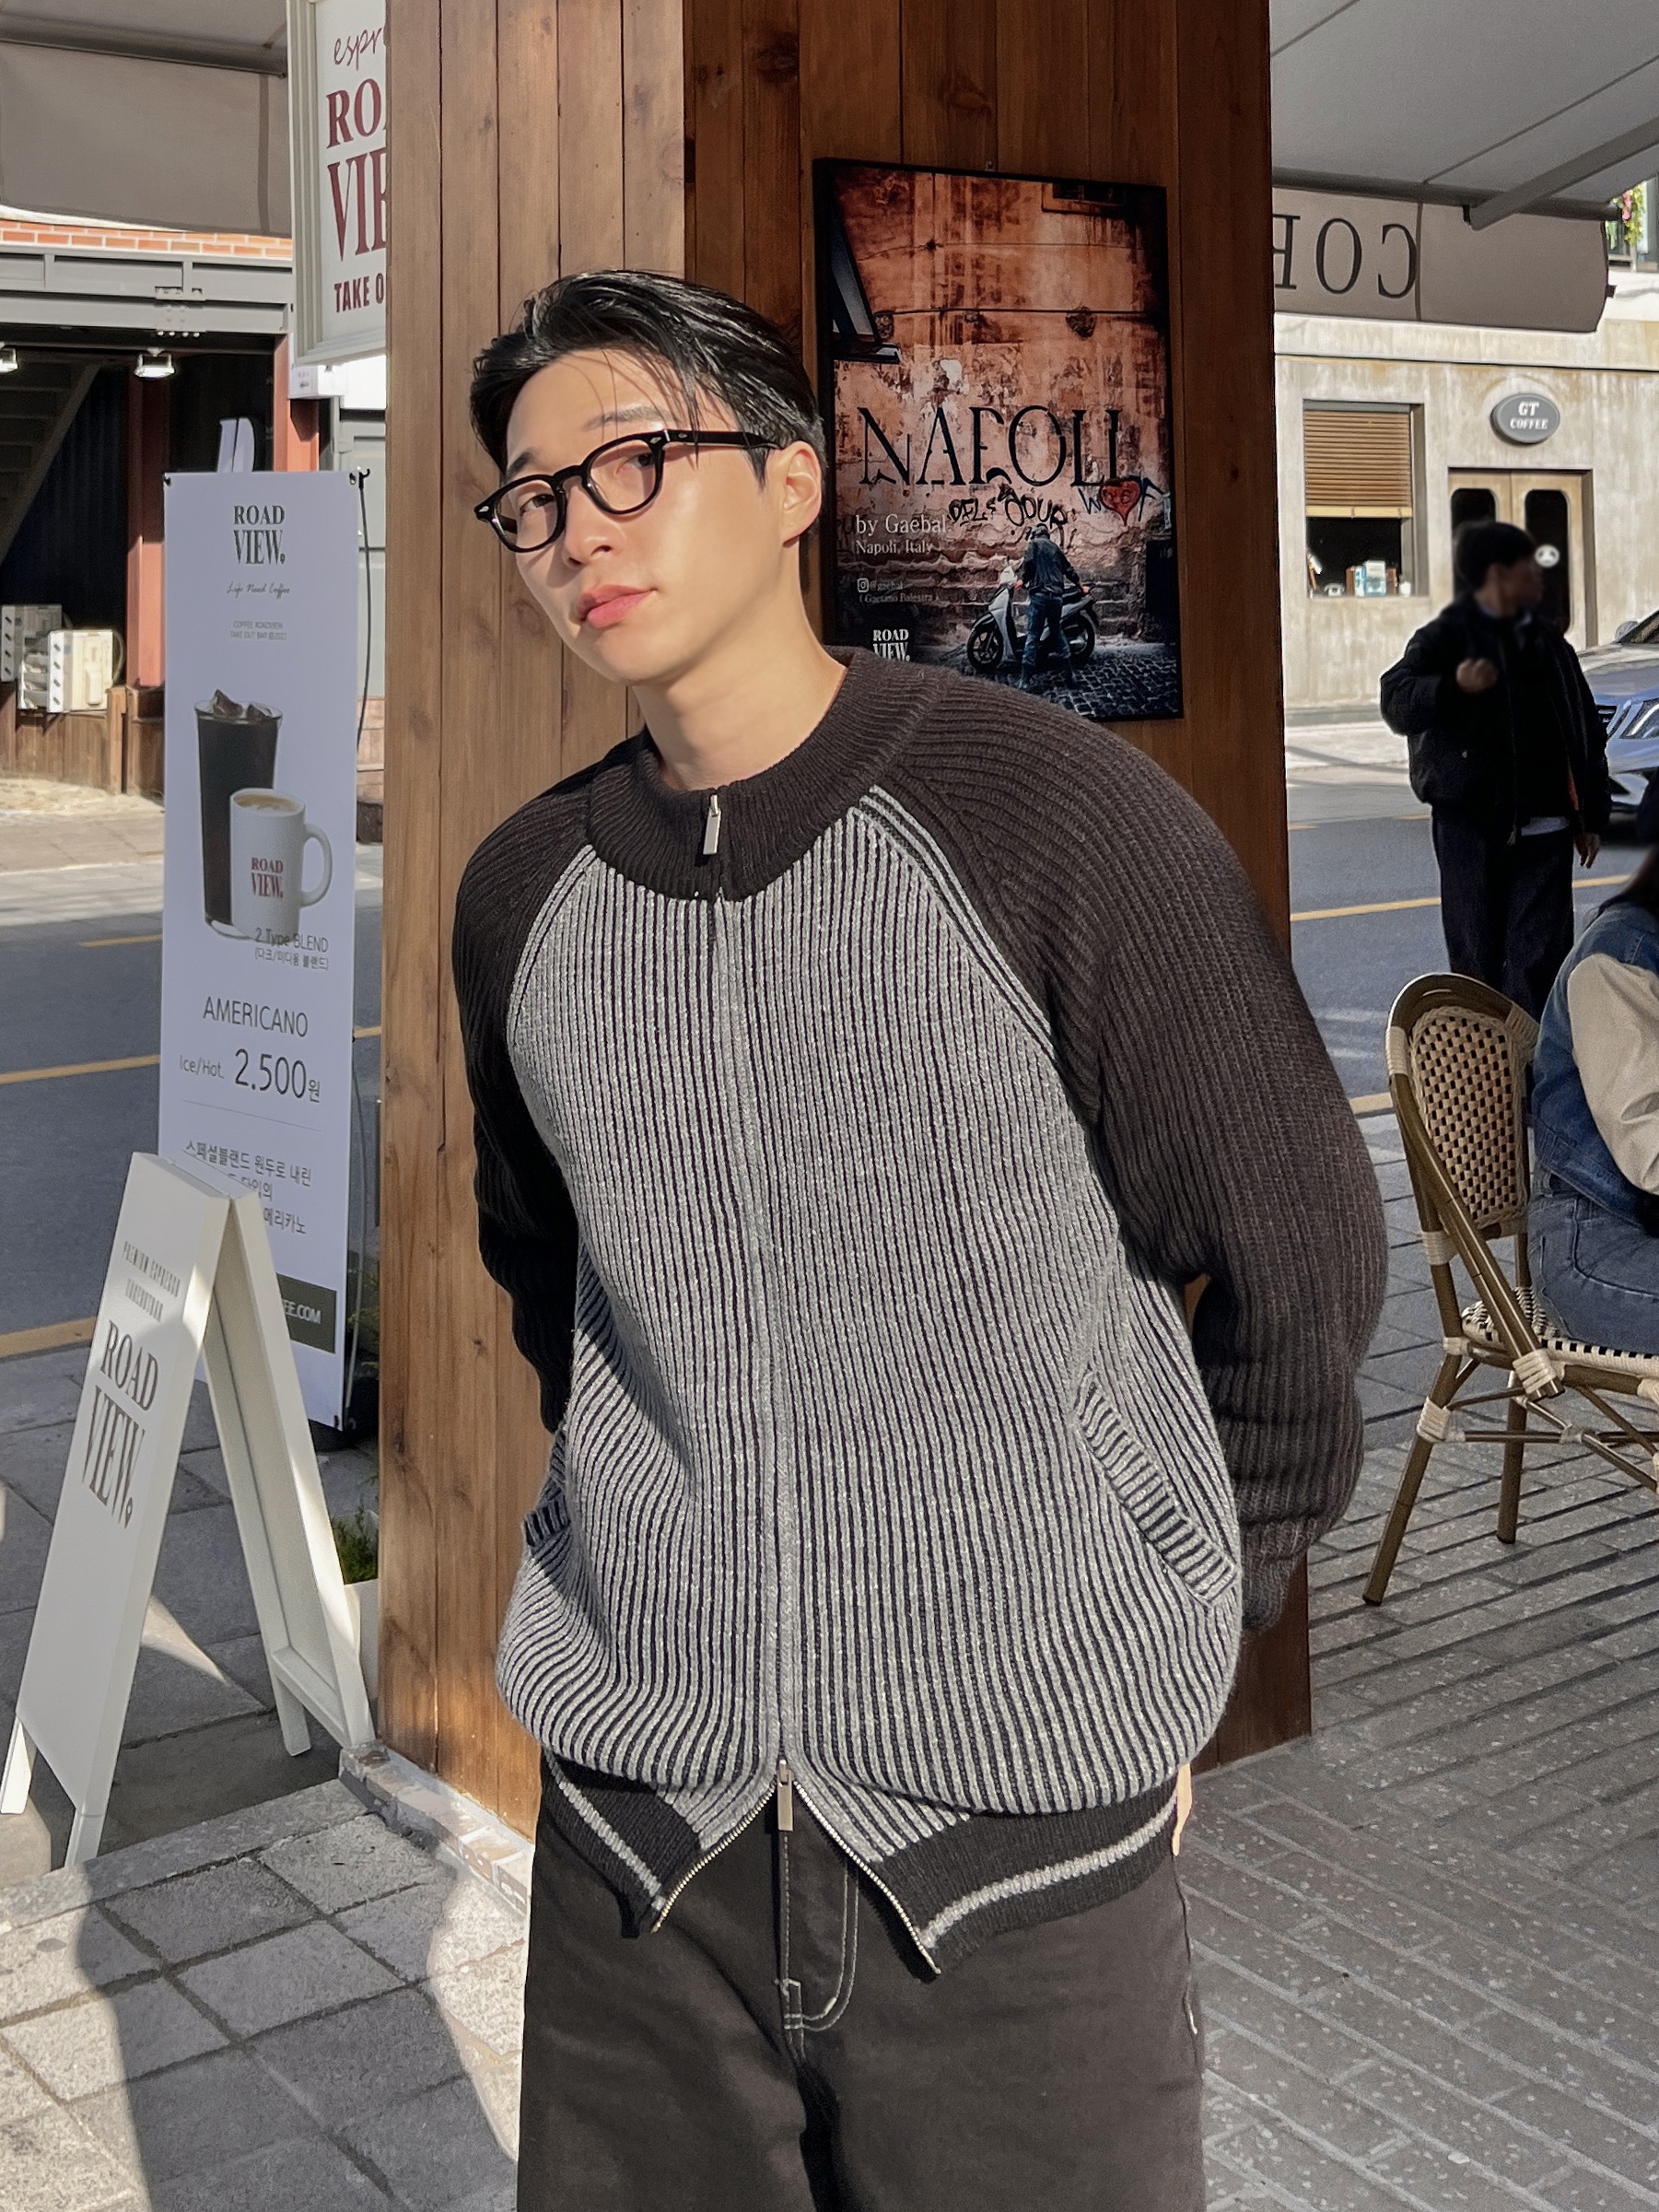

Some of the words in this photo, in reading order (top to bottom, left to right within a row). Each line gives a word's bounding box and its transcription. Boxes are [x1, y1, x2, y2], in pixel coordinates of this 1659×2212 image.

[326, 77, 386, 149] RO
[333, 275, 370, 313] TAKE
[1518, 401, 1539, 416] GT
[1510, 418, 1548, 430] COFFEE
[233, 505, 286, 525] ROAD
[856, 514, 878, 537] by
[905, 539, 934, 555] Italy
[872, 628, 910, 642] ROAD
[251, 857, 284, 873] ROAD
[255, 927, 263, 943] 2
[265, 928, 290, 949] Type
[293, 932, 329, 954] BLEND
[203, 996, 309, 1037] AMERICANO
[254, 1154, 286, 1178] 원두로
[289, 1164, 311, 1188] 내린
[100, 1319, 158, 1412] ROAD
